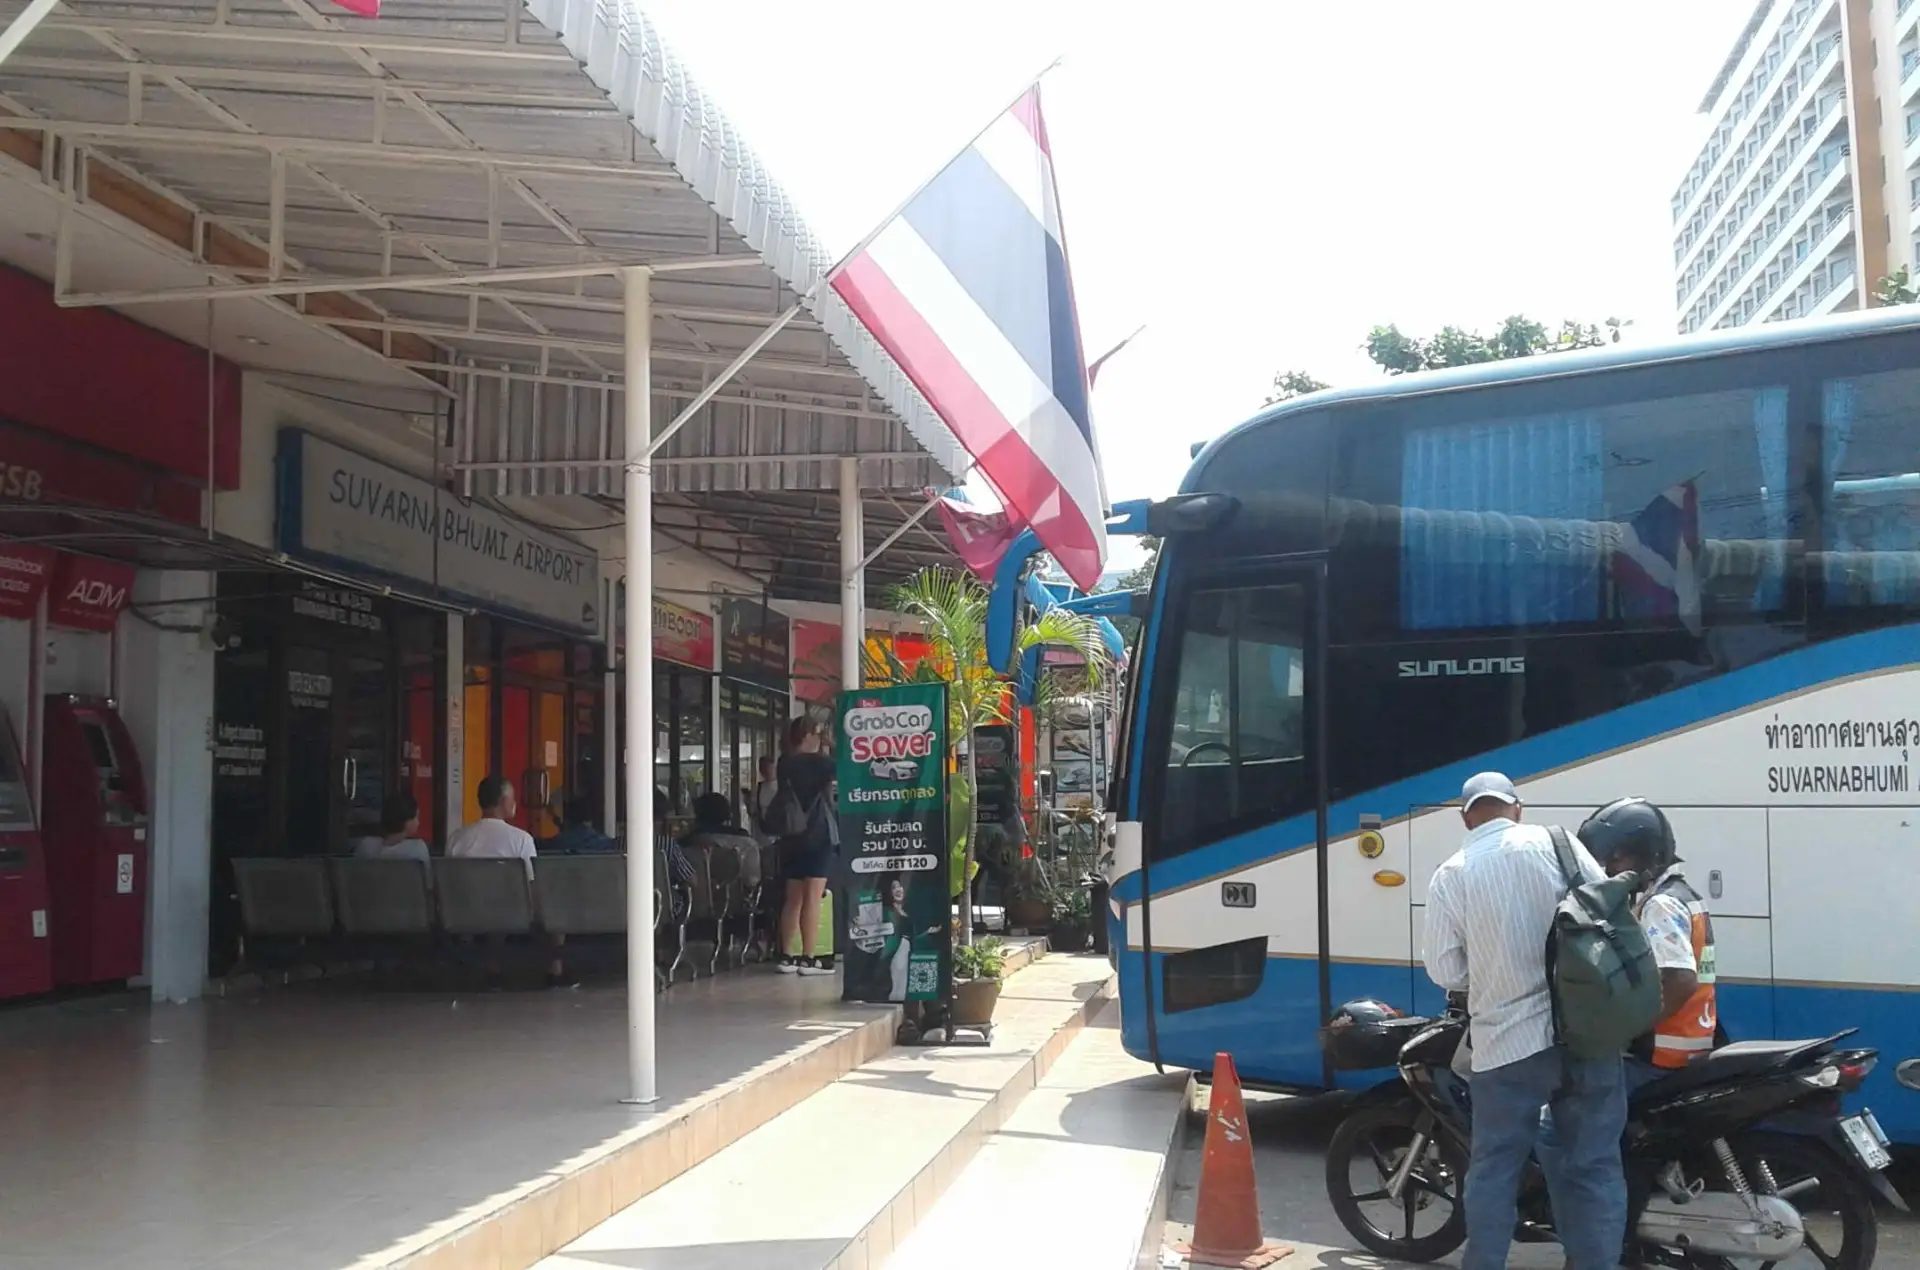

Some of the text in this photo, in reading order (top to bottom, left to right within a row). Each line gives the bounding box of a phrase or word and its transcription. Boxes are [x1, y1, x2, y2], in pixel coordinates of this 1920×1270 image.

[329, 468, 585, 585] SUVARNABHUMI AIRPORT
[67, 579, 126, 609] ADM
[1398, 656, 1525, 677] SUNLONG
[852, 732, 936, 762] saver
[1768, 765, 1909, 793] SUVARNABHUMI
[864, 819, 923, 835] รับส่วนลด
[890, 837, 909, 850] 120
[886, 857, 928, 870] GET120
